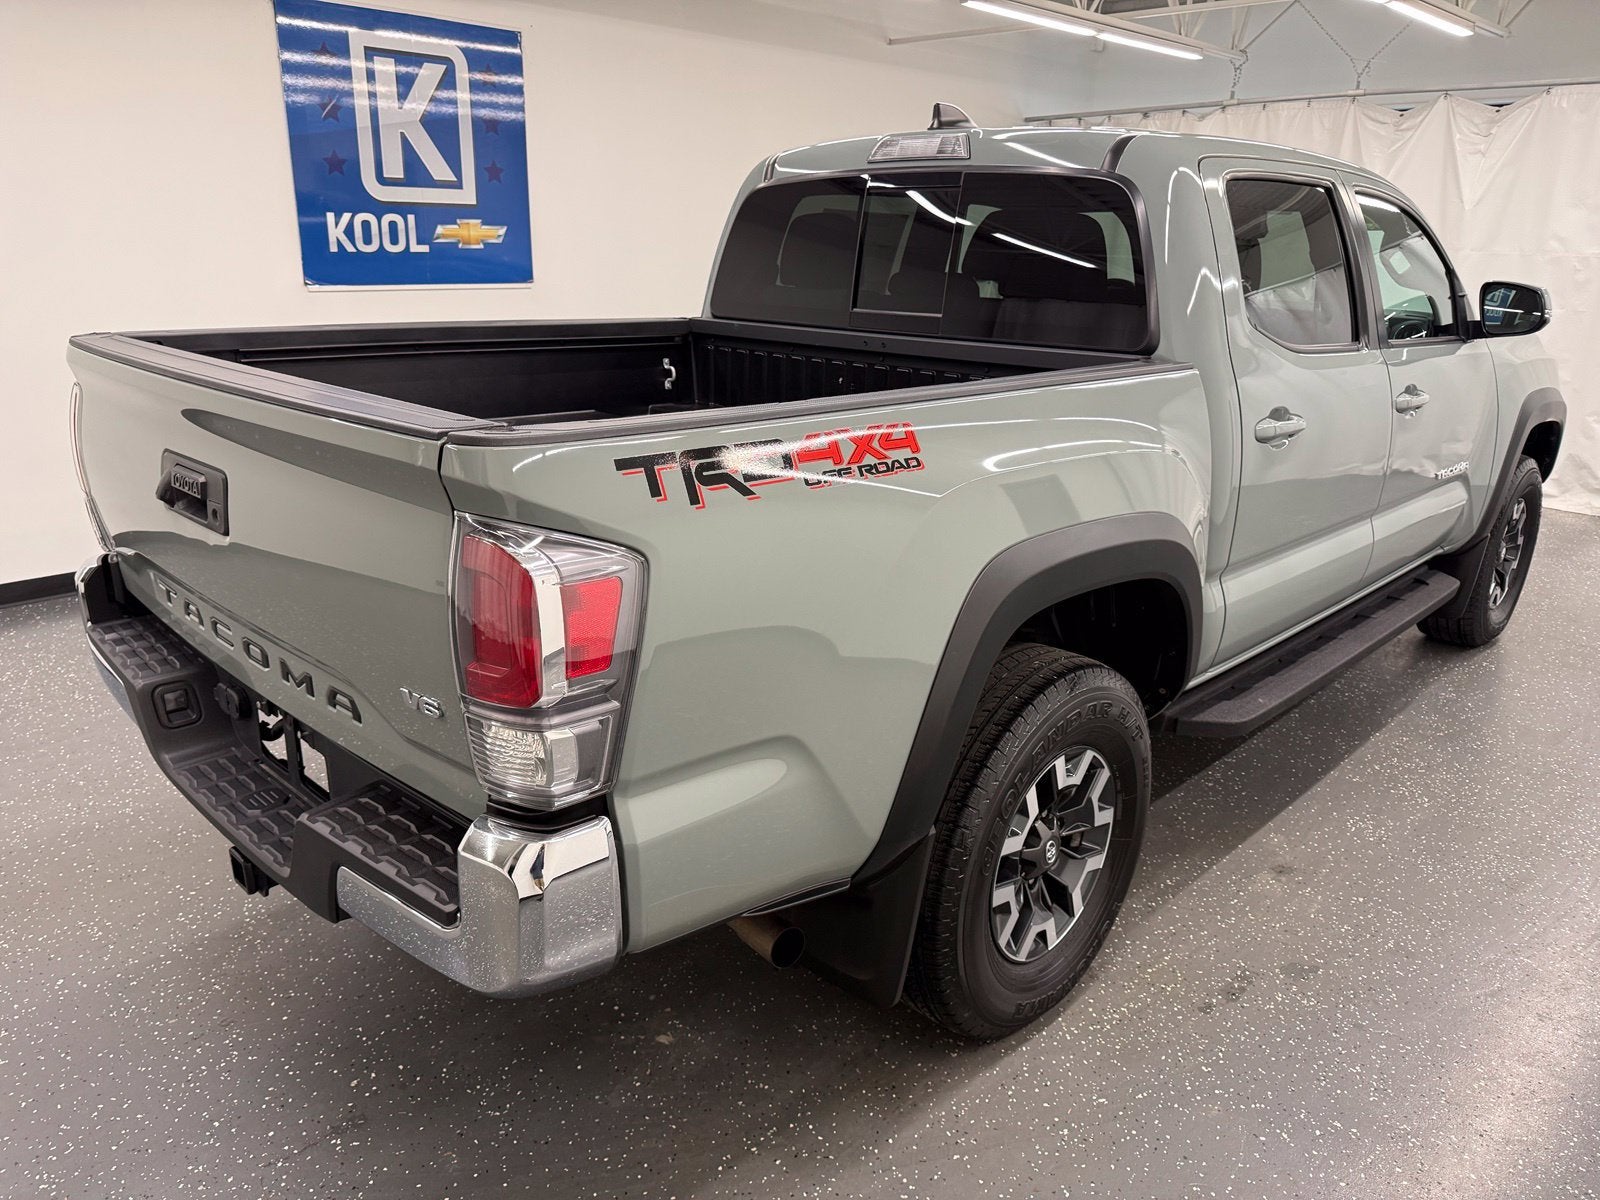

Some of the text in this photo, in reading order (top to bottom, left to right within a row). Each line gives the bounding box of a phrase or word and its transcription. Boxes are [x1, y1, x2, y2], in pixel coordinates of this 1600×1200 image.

[373, 56, 458, 182] K
[325, 211, 430, 253] KOOL
[172, 472, 201, 496] TOYOTA
[613, 438, 796, 510] TRD
[858, 456, 925, 479] ROAD
[158, 577, 363, 727] TACOMA
[399, 687, 445, 719] V6
[1114, 705, 1144, 742] H/T
